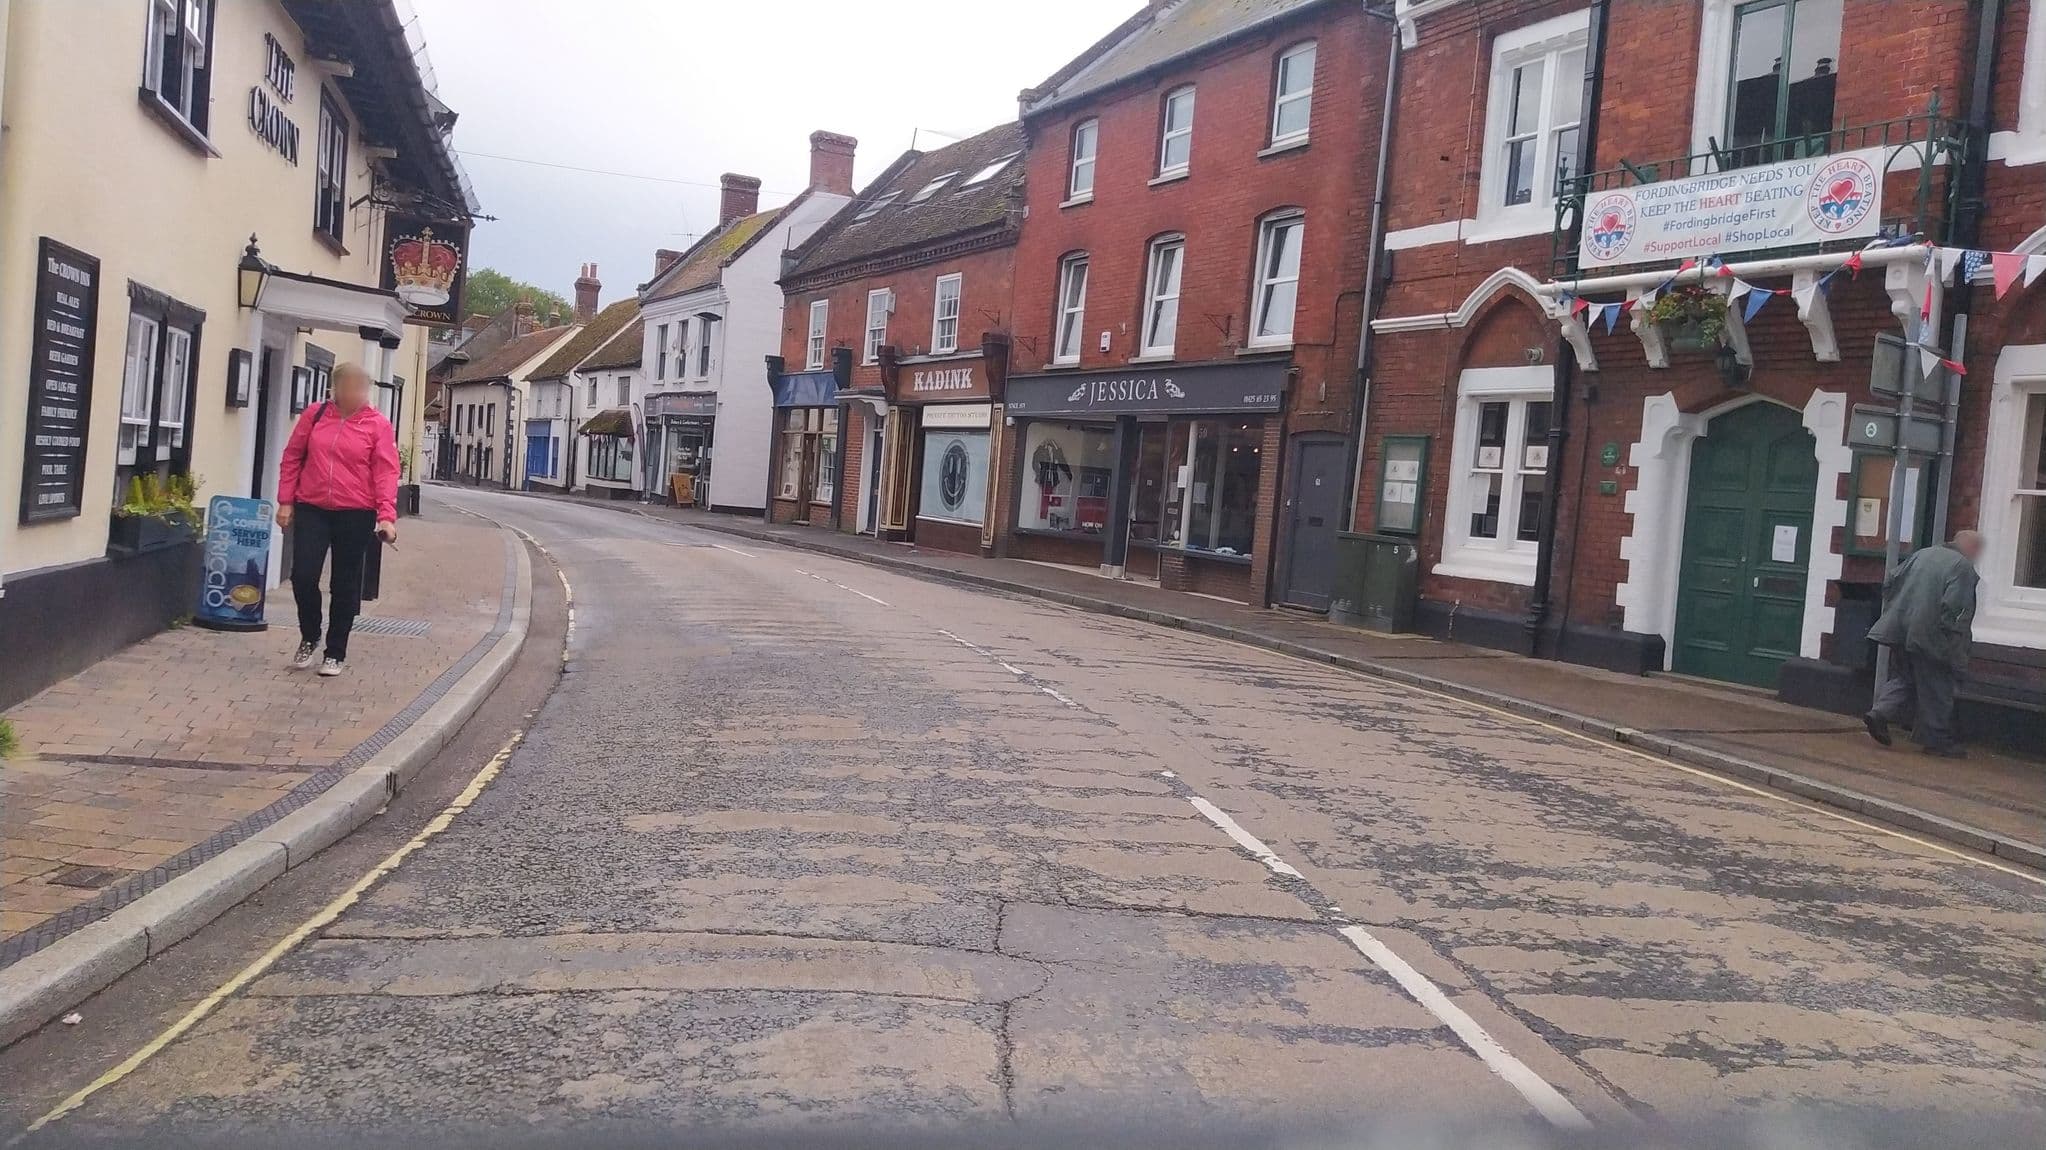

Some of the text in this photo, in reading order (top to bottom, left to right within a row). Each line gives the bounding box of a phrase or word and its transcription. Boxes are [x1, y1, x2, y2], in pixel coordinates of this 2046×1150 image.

[264, 31, 295, 104] THE
[247, 85, 300, 168] CROWN
[1635, 163, 1817, 201] FORDINGBRIDGE NEEDS YOU
[1810, 160, 1874, 229] KEEP THE HEART BEATING
[1640, 185, 1804, 218] KEEP THE HEART BEATING
[1663, 207, 1777, 231] #FordingbridgeFirst
[1643, 224, 1794, 254] #SupportLocal #ShopLocal
[48, 257, 59, 274] The
[59, 262, 80, 283] CROWN
[413, 309, 451, 321] CROWN
[46, 379, 57, 390] OPEN
[913, 368, 973, 392] KADINK
[1088, 379, 1159, 405] JESSICA
[232, 528, 269, 540] SERVED
[236, 536, 261, 548] HERE
